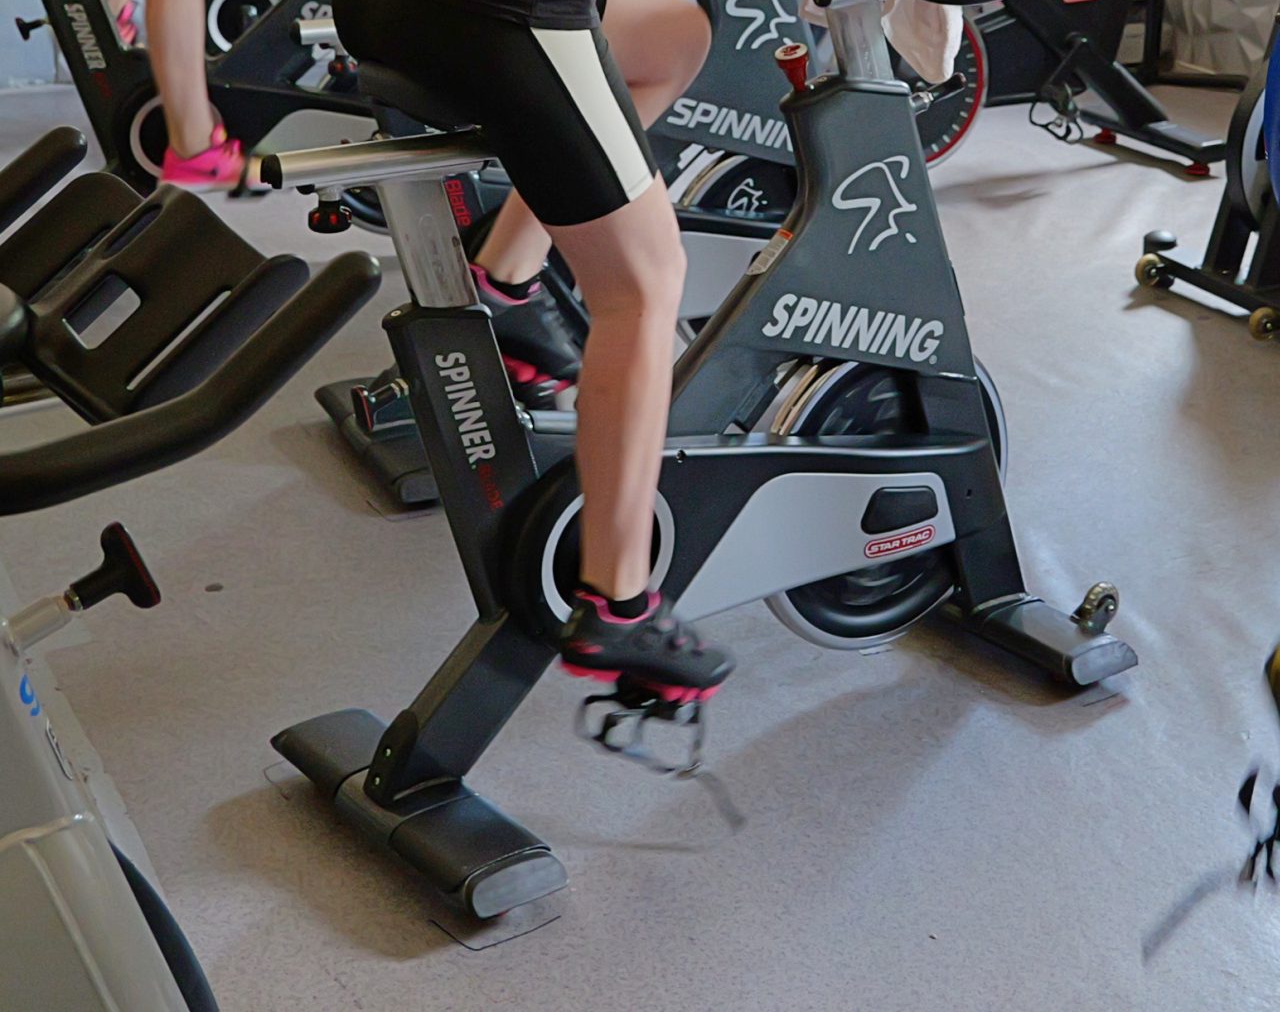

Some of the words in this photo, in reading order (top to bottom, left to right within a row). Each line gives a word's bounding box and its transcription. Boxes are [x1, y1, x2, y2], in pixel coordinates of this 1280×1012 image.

[761, 292, 945, 364] SPINNING
[434, 351, 497, 465] SPINNER
[870, 539, 901, 553] STAR
[901, 530, 931, 546] TRAC
